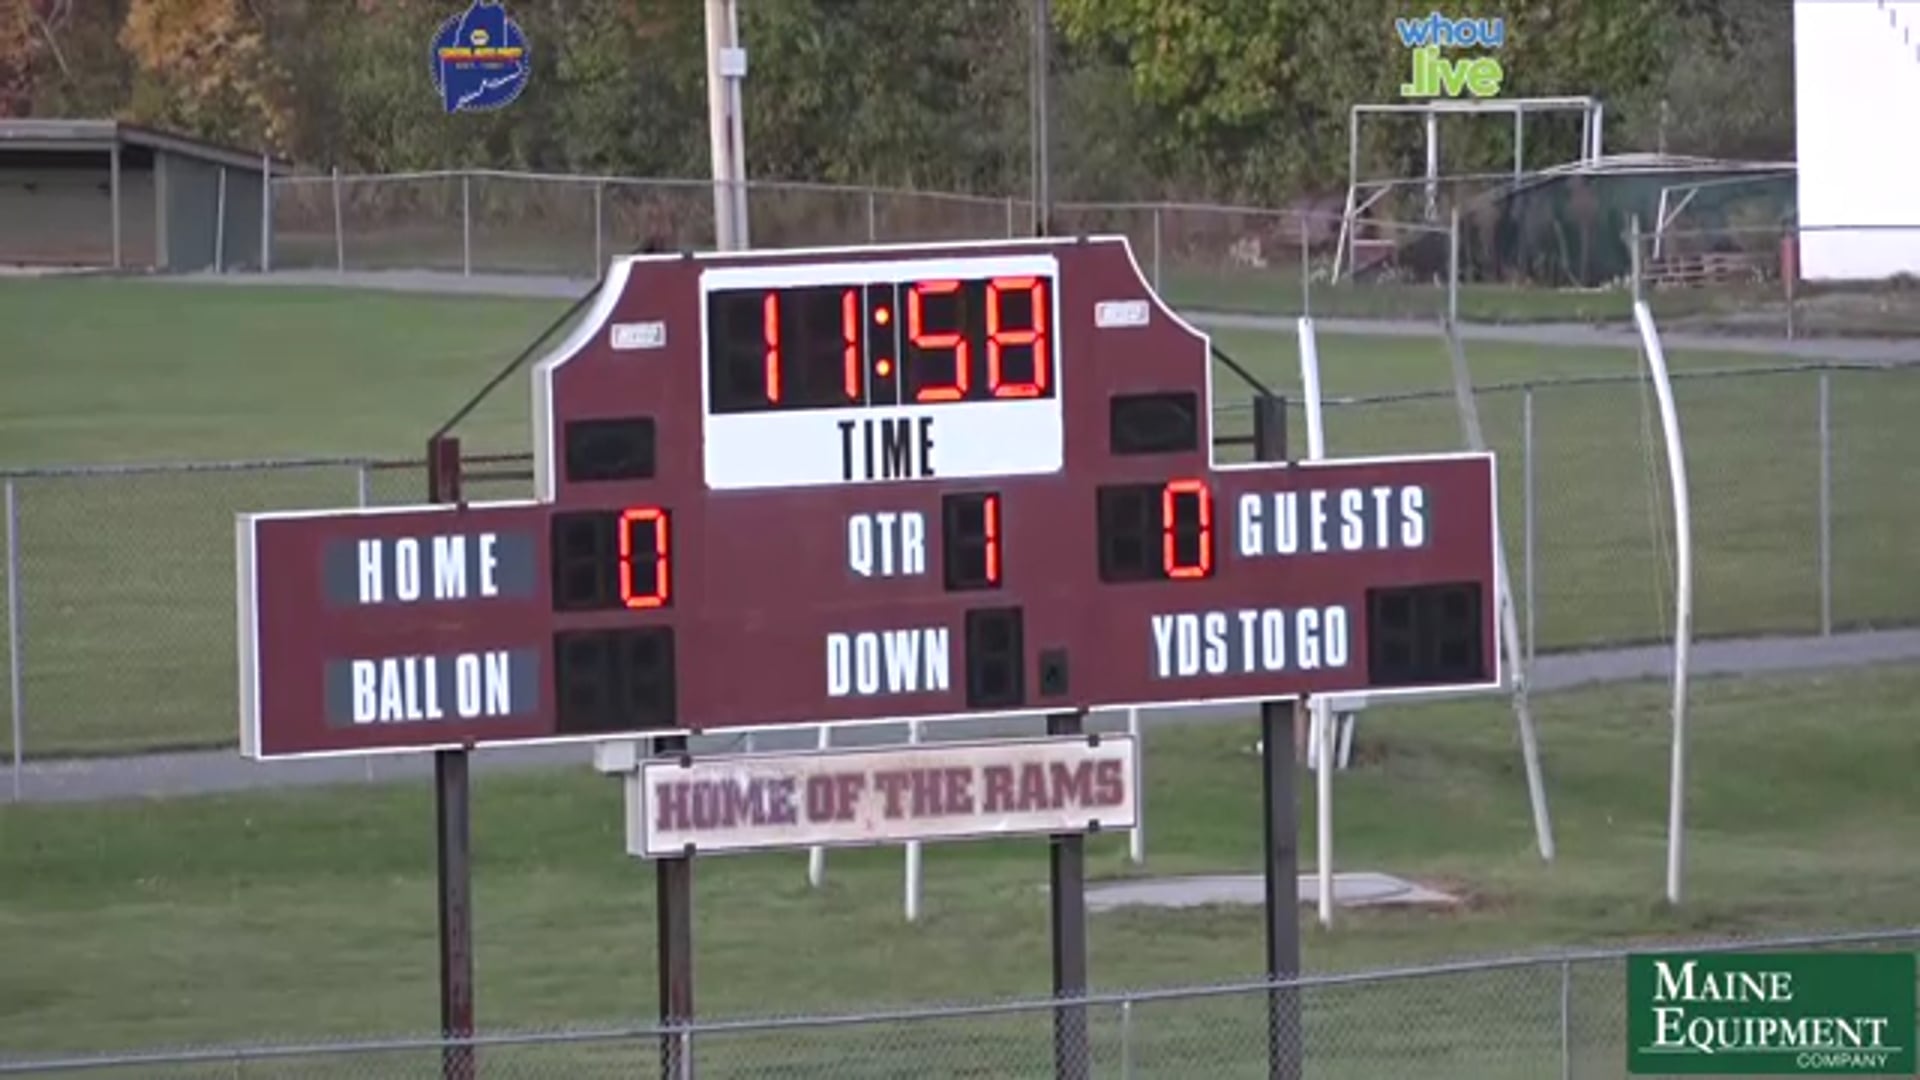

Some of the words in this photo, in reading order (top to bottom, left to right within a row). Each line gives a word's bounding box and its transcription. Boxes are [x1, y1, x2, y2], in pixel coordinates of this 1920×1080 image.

[762, 276, 1047, 405] 11:58
[838, 416, 935, 481] TIME
[619, 507, 669, 608] 0
[849, 511, 925, 577] QTR
[983, 493, 1001, 586] 1
[1162, 479, 1211, 579] 0
[1239, 485, 1424, 557] GUESTS
[358, 533, 498, 604] HOME
[827, 627, 949, 697] DOWN
[1152, 611, 1228, 678] YDS
[1238, 609, 1286, 672] TO
[1296, 605, 1349, 670] GO
[351, 656, 443, 724] BALL
[455, 651, 510, 719] ON
[655, 776, 797, 832] HOME
[806, 772, 867, 823] OF
[874, 765, 974, 818] THE
[983, 759, 1125, 813] RAMS
